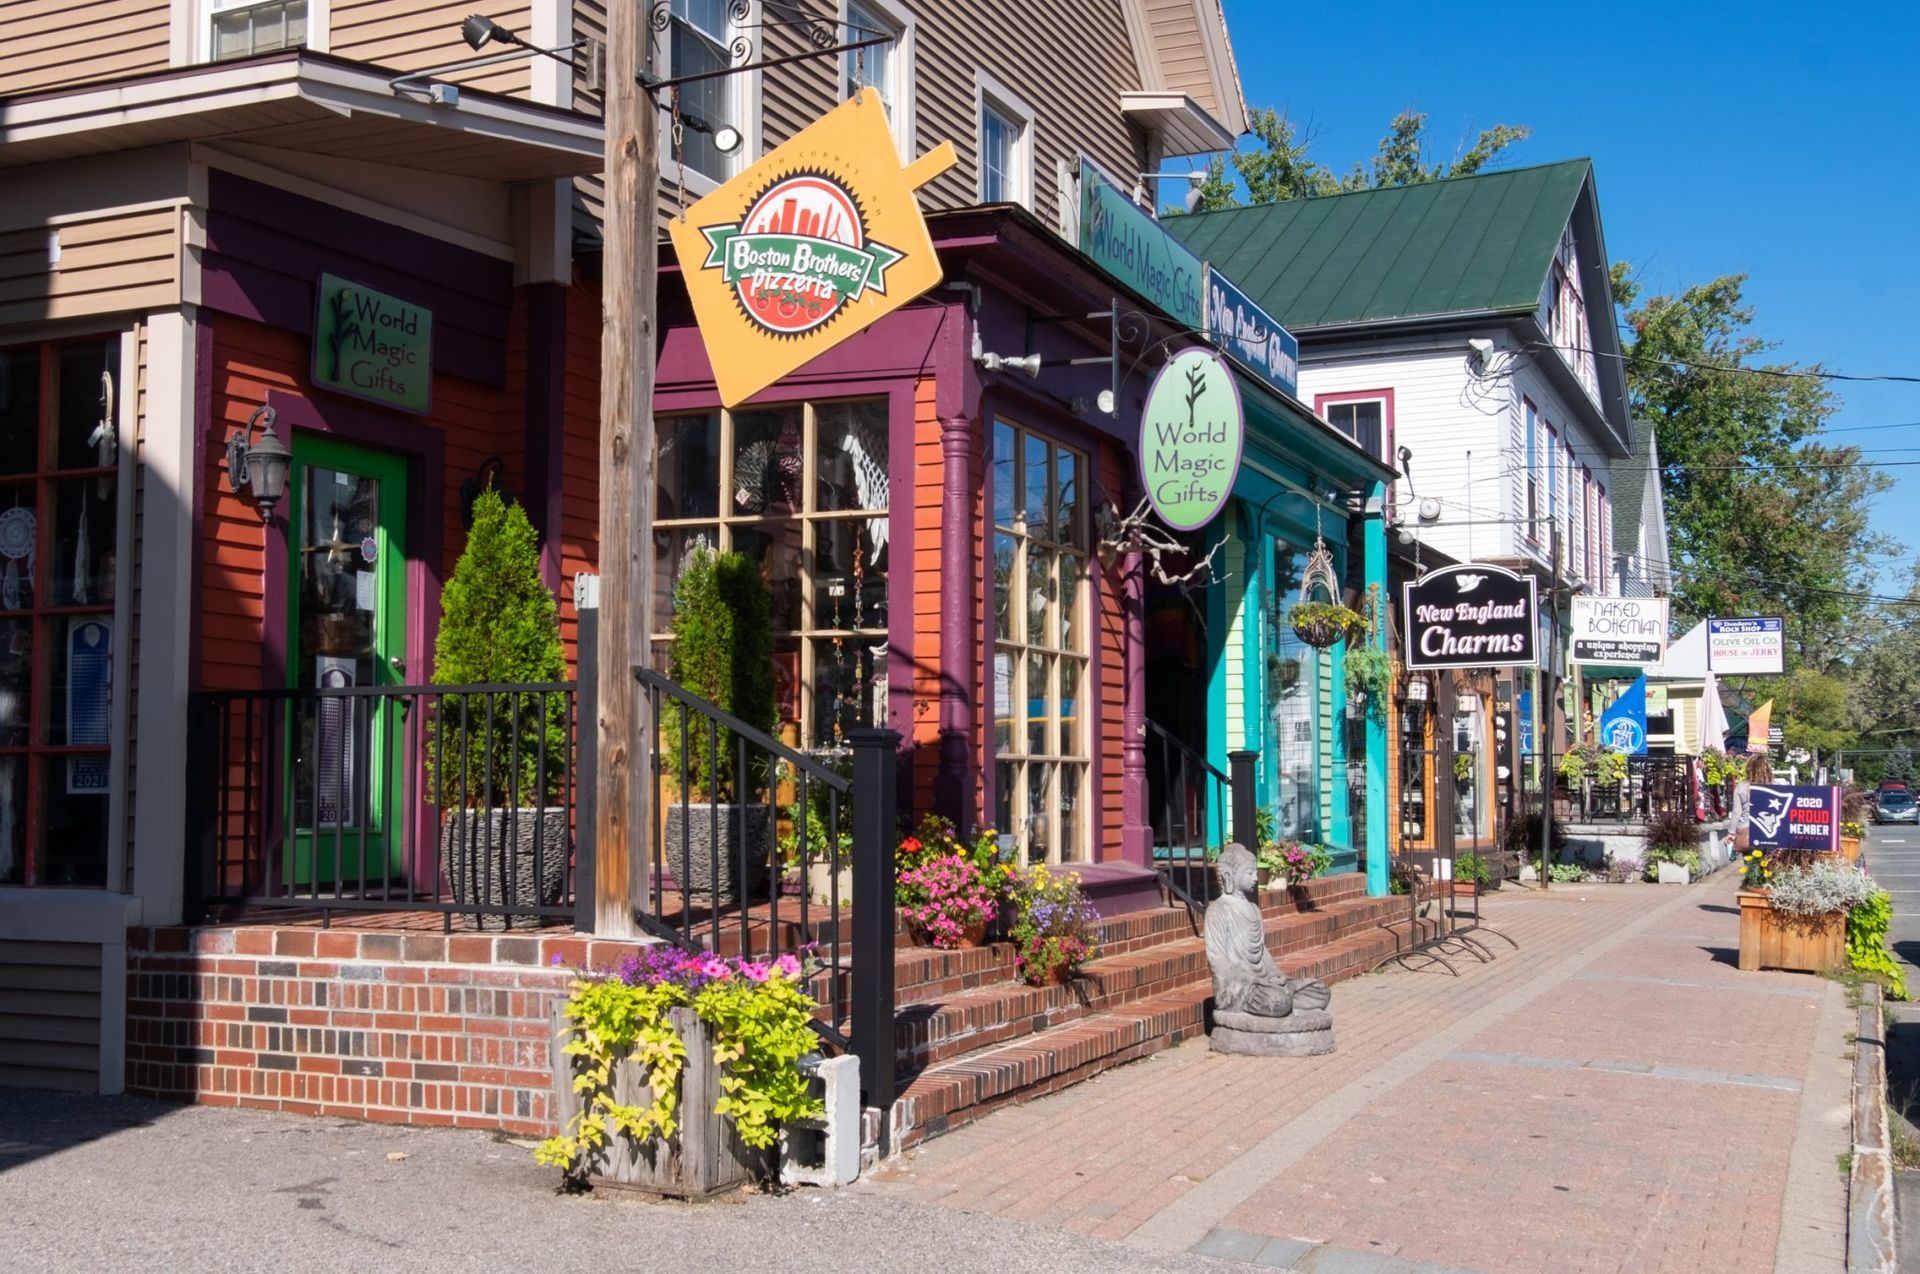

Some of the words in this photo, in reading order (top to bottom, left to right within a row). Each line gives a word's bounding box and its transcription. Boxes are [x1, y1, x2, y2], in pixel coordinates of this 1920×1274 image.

[733, 240, 790, 270] Boston
[791, 243, 865, 281] Brothers'
[1100, 207, 1135, 270] World
[1137, 234, 1171, 304] Magic
[1172, 266, 1200, 322] Gifts
[749, 267, 833, 299] pizzeria
[355, 292, 418, 335] World
[352, 322, 416, 367] Magic
[350, 360, 406, 395] Gifts
[1155, 421, 1226, 446] World
[1154, 449, 1226, 478] Magic
[1156, 480, 1218, 505] Gifts
[1416, 604, 1454, 623] New
[1455, 598, 1526, 625] England
[1593, 601, 1640, 618] NAKED
[1588, 617, 1661, 637] BOHEMIAN
[1420, 625, 1525, 657] Charms
[1586, 641, 1616, 651] unique
[1618, 641, 1658, 654] shopping
[1712, 637, 1741, 646] OLIVE
[1743, 637, 1761, 645] OIL
[1712, 649, 1739, 657] HOUSE
[1750, 647, 1779, 657] JERKY
[1593, 650, 1641, 660] experience
[1796, 797, 1823, 808] 2020
[1790, 809, 1829, 823] PROUD
[1789, 823, 1829, 836] MEMBER
